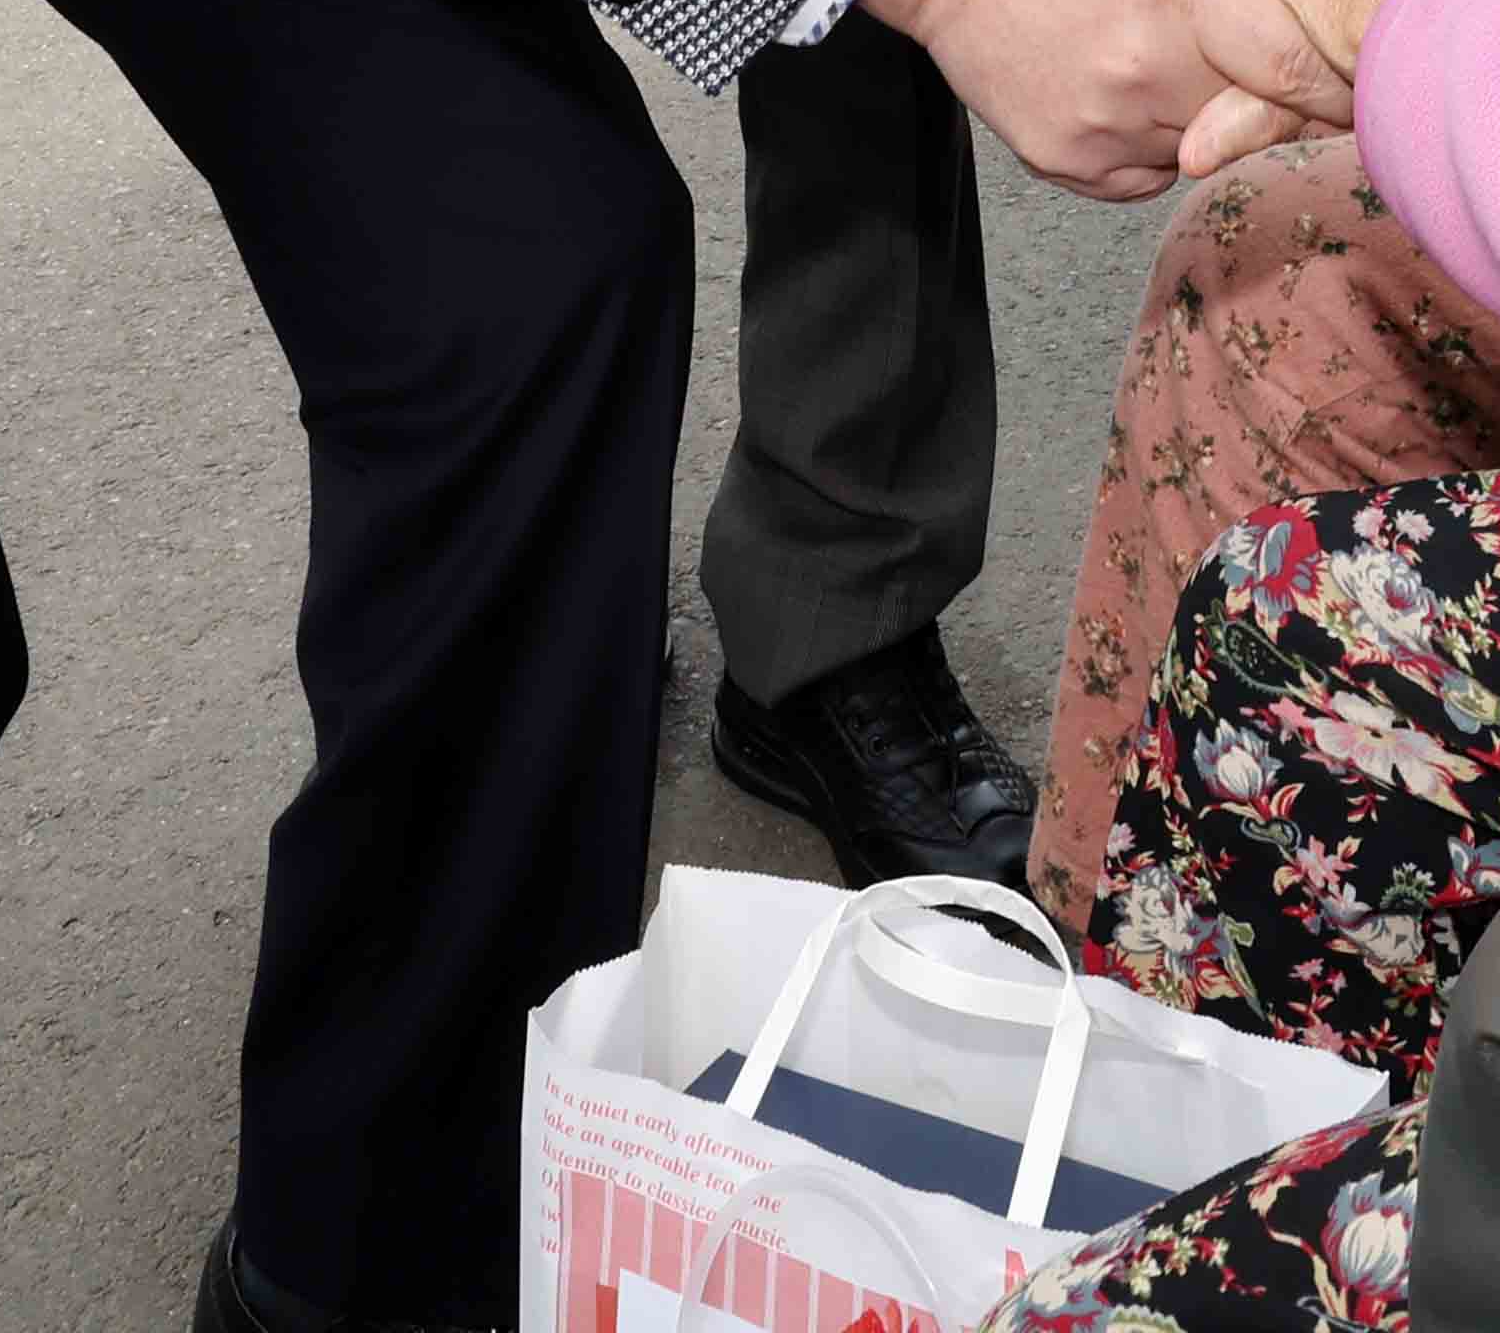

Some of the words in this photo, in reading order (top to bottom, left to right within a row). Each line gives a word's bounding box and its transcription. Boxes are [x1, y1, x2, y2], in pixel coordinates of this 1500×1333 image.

[564, 1091, 575, 1108] a
[579, 1097, 629, 1124] quiet
[634, 1111, 678, 1139] early
[580, 1125, 606, 1147] an
[610, 1137, 701, 1183] agreeable
[624, 1169, 644, 1189] to
